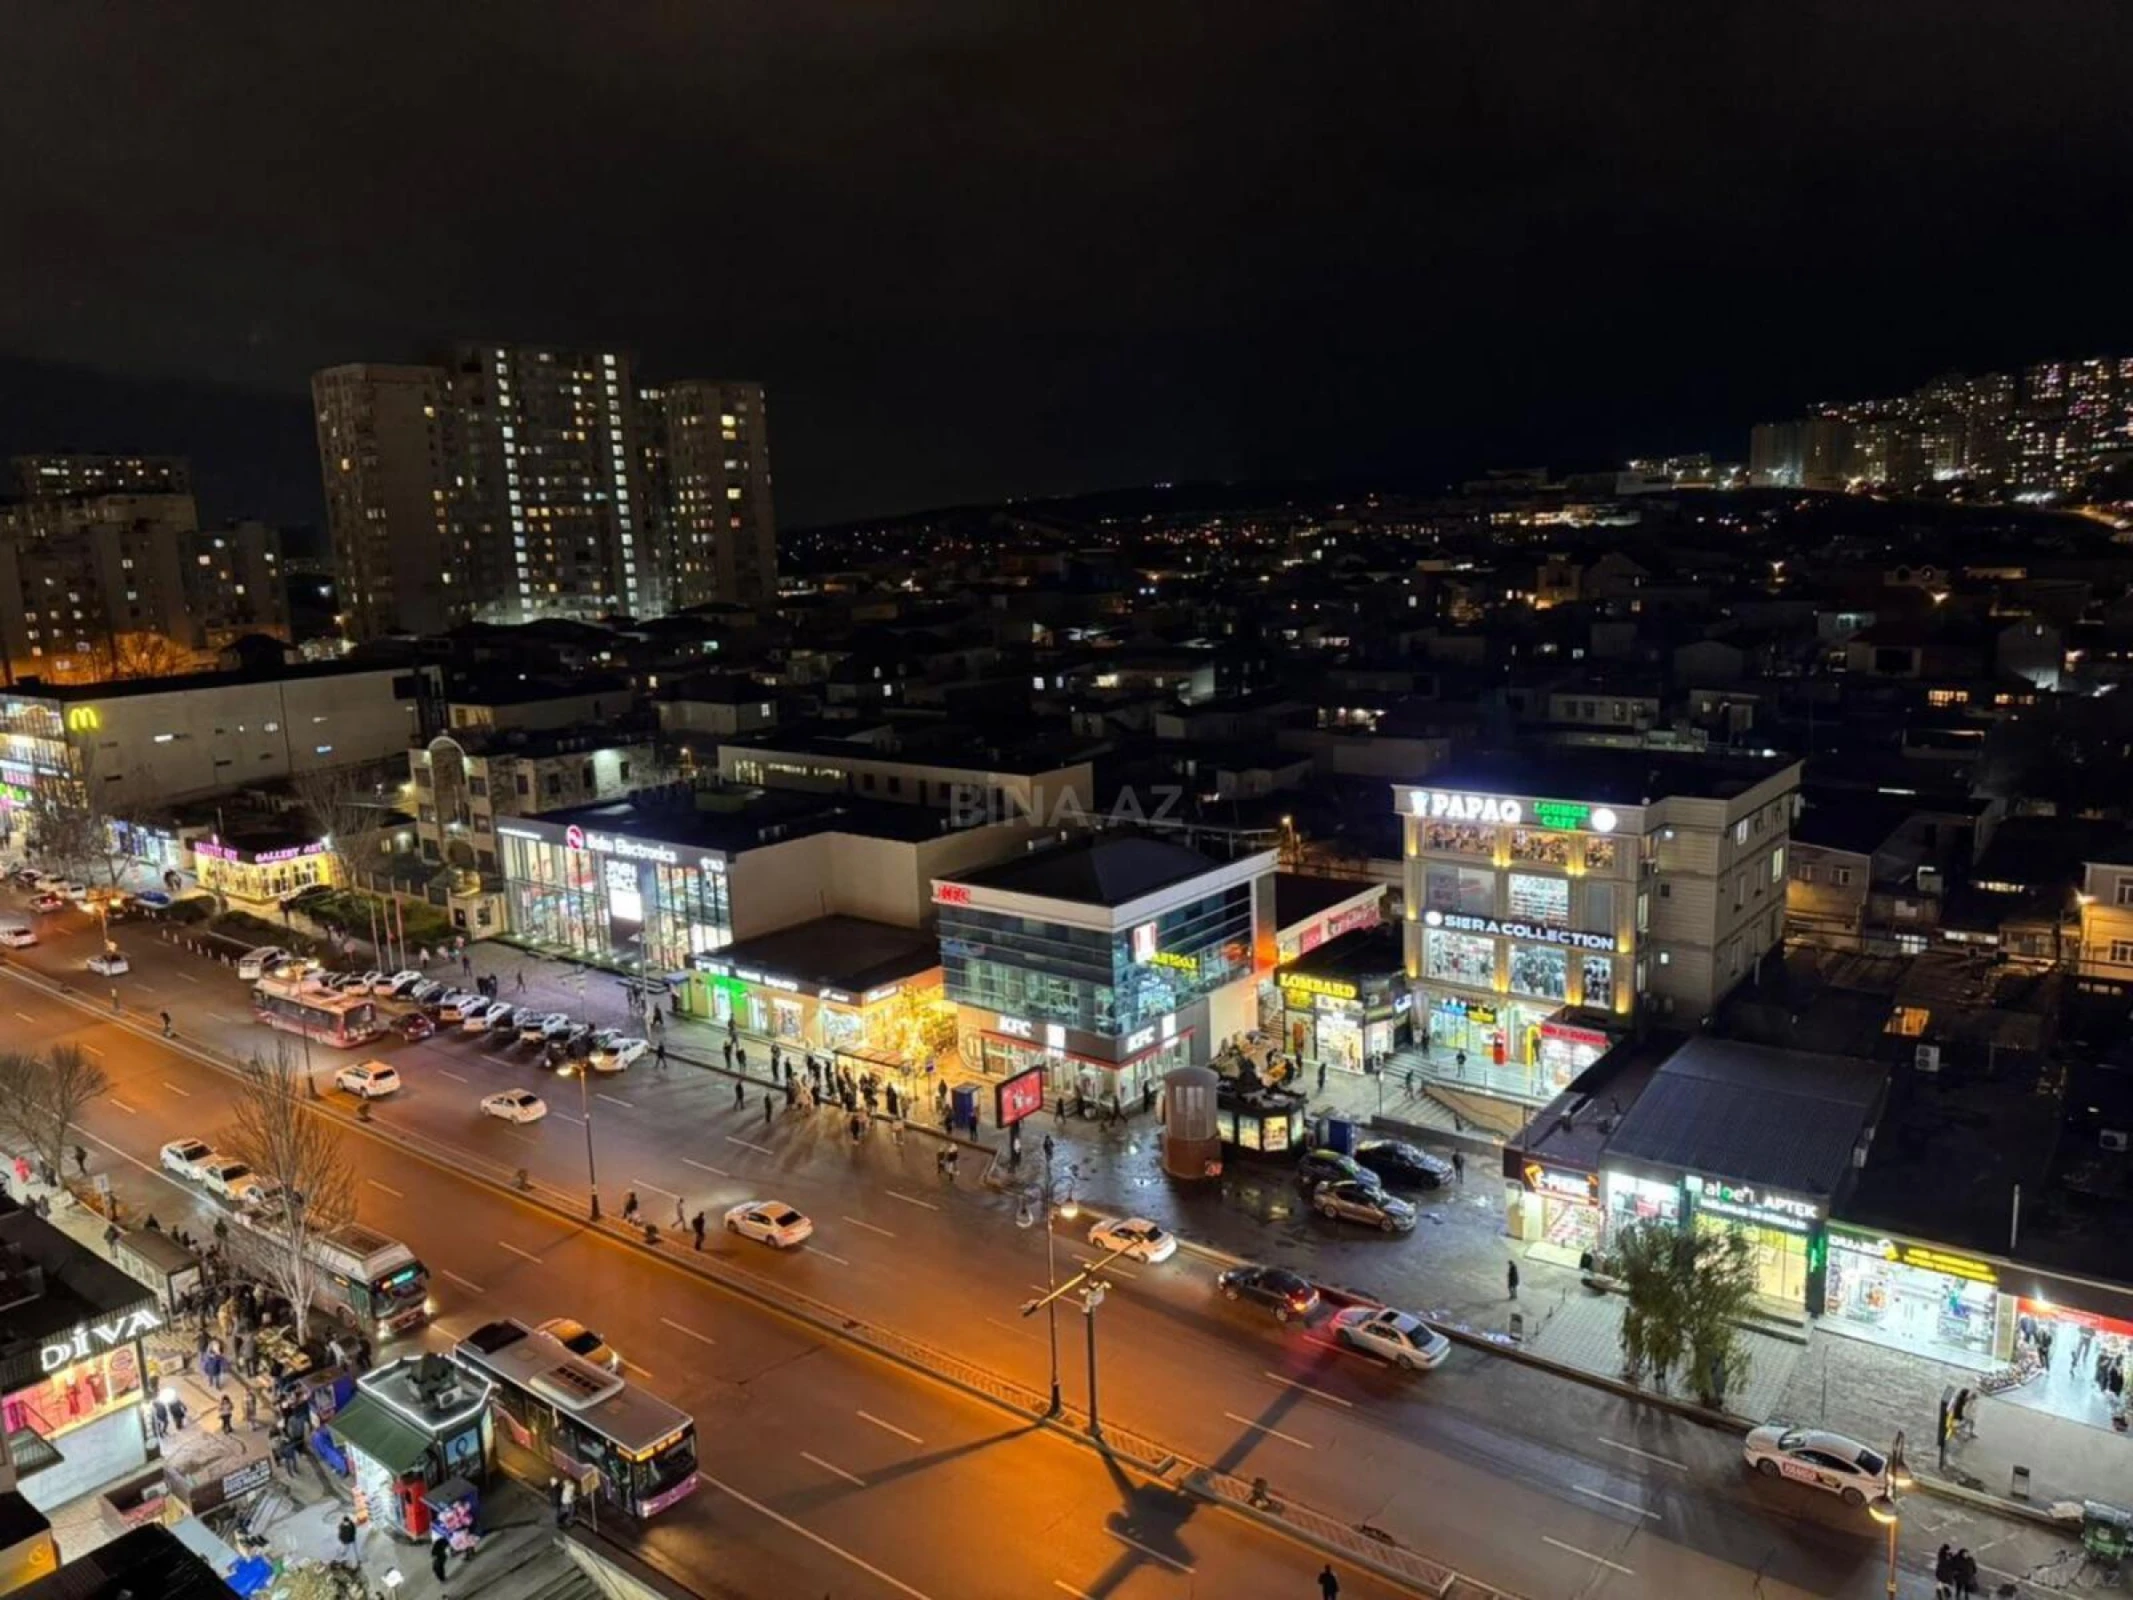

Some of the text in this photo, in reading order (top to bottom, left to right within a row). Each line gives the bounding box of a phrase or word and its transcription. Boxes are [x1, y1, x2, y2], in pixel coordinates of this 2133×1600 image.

[1431, 793, 1522, 824] PAPAQ
[1533, 801, 1590, 819] LOUNGE
[1279, 972, 1358, 999] LOMBARD
[999, 1014, 1032, 1037] KFC
[1126, 1025, 1156, 1053] KFC
[1763, 1194, 1818, 1219] APTEK
